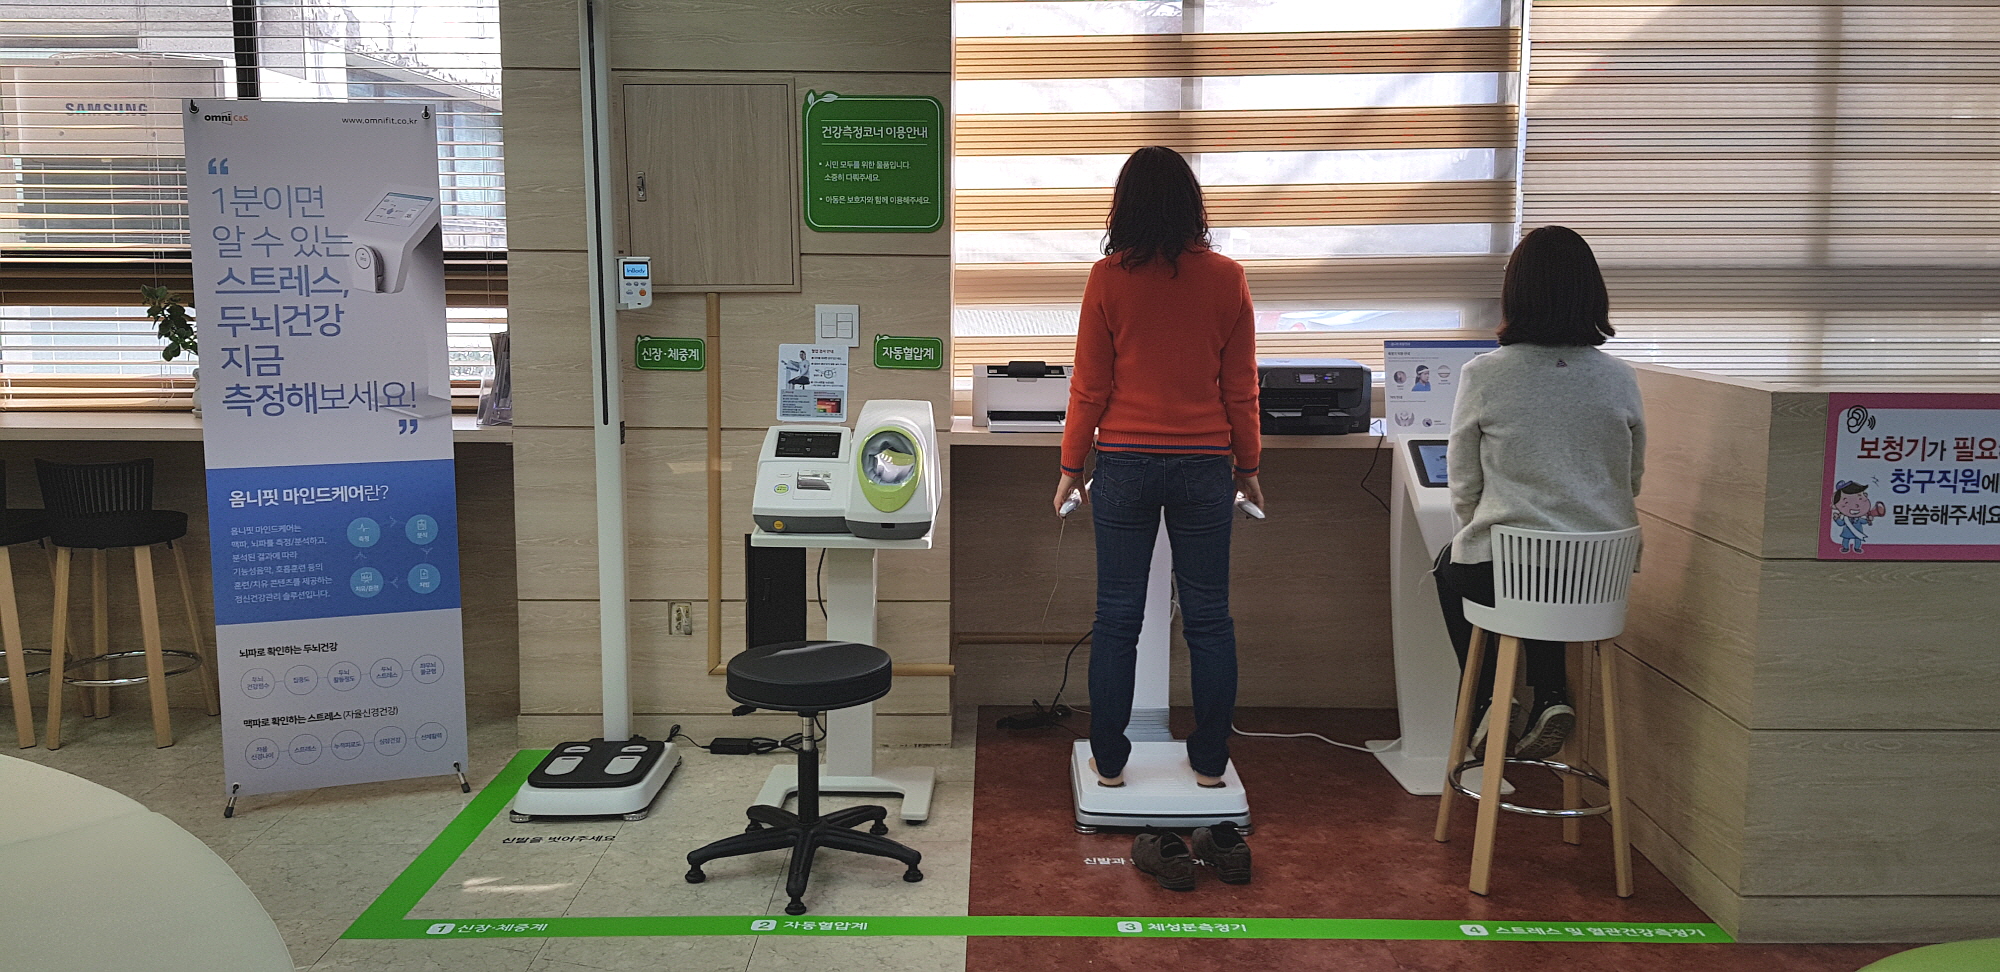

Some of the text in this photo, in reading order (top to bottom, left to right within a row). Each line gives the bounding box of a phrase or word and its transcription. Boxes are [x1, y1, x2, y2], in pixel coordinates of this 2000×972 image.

[65, 103, 148, 116] SAMSUNG
[204, 113, 232, 122] omni
[341, 116, 418, 125] www.omnifit.co.kr
[822, 126, 928, 139] 건강측정코너 이용안내
[824, 160, 839, 169] 시민
[840, 160, 860, 169] 모두를
[861, 160, 875, 169] 위한
[824, 173, 845, 182] 소중히
[211, 185, 325, 218] 1분이면
[825, 195, 845, 205] 아동은
[847, 195, 874, 205] 보호자와
[875, 195, 889, 205] 함께
[212, 225, 353, 258] 알 수 있는
[215, 264, 349, 298] 스트레스,
[217, 303, 345, 338] 두뇌건강
[641, 347, 700, 361] 신장·체중계
[882, 346, 934, 360] 자동혈압계
[221, 344, 284, 377] 지금
[222, 380, 417, 417] 측정해보세요!
[1857, 436, 2000, 462] 보청기가 필요
[228, 484, 389, 508] 옴니핏 마인드케어란?
[1893, 504, 2000, 526] 말씀해주세요
[230, 524, 302, 536] 옴니핏 마인드케어는
[231, 540, 250, 549] 맥파,
[251, 539, 275, 548] 뇌파를
[231, 550, 298, 563] 분석된 결과에 따라
[307, 562, 323, 572] 등의
[302, 576, 333, 586] 제공하는
[234, 592, 281, 604] 정신건강관리
[239, 641, 338, 658] 뇌파로 확인하는 두뇌건강
[376, 671, 398, 679] 스트레스
[243, 705, 399, 729] 맥파로 확인하는 스트레스 (자율신경건강)
[293, 746, 317, 754] 스트레스
[502, 834, 617, 846] 신발을 벗어주세요
[1084, 857, 1126, 865] 신발과
[757, 920, 868, 932] 2 자동혈압계
[1124, 922, 1247, 933] 3 체성분측정기
[1496, 926, 1563, 936] 스트레스
[1565, 927, 1586, 937] 및
[1586, 927, 1705, 937] 혈관건강측정기
